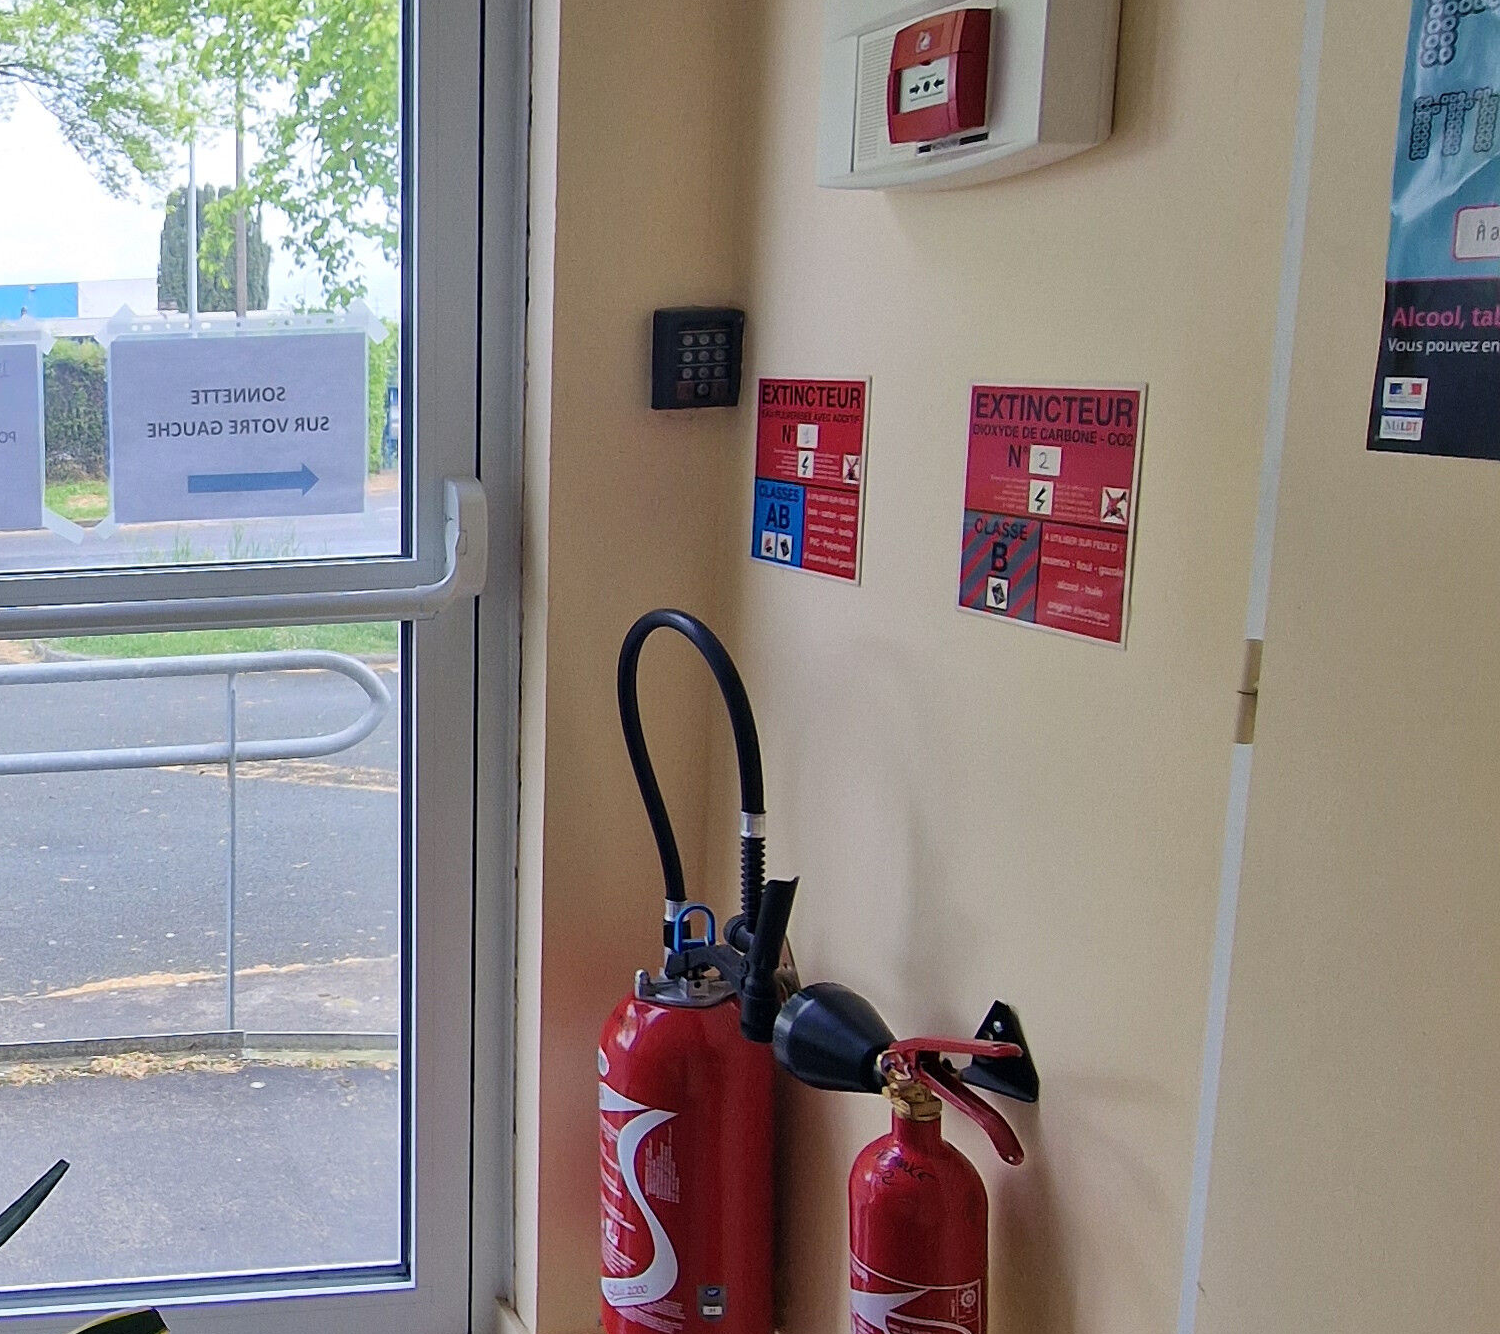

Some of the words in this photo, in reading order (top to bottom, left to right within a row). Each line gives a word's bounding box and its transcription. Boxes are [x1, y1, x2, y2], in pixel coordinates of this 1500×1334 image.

[1391, 305, 1465, 329] Alcool,
[1388, 338, 1423, 353] Vous
[1426, 340, 1478, 356] pouvez
[762, 384, 861, 409] EXTINCTEUR
[975, 392, 1134, 428] EXTINCTEUR
[973, 423, 1019, 440] DIOXYDE
[1022, 426, 1038, 440] DE
[1040, 429, 1097, 444] CARBONE
[1108, 433, 1133, 447] CO2
[1038, 451, 1050, 470] 2
[765, 503, 791, 530] AB
[974, 518, 1028, 541] CLASSE
[991, 541, 1008, 572] B
